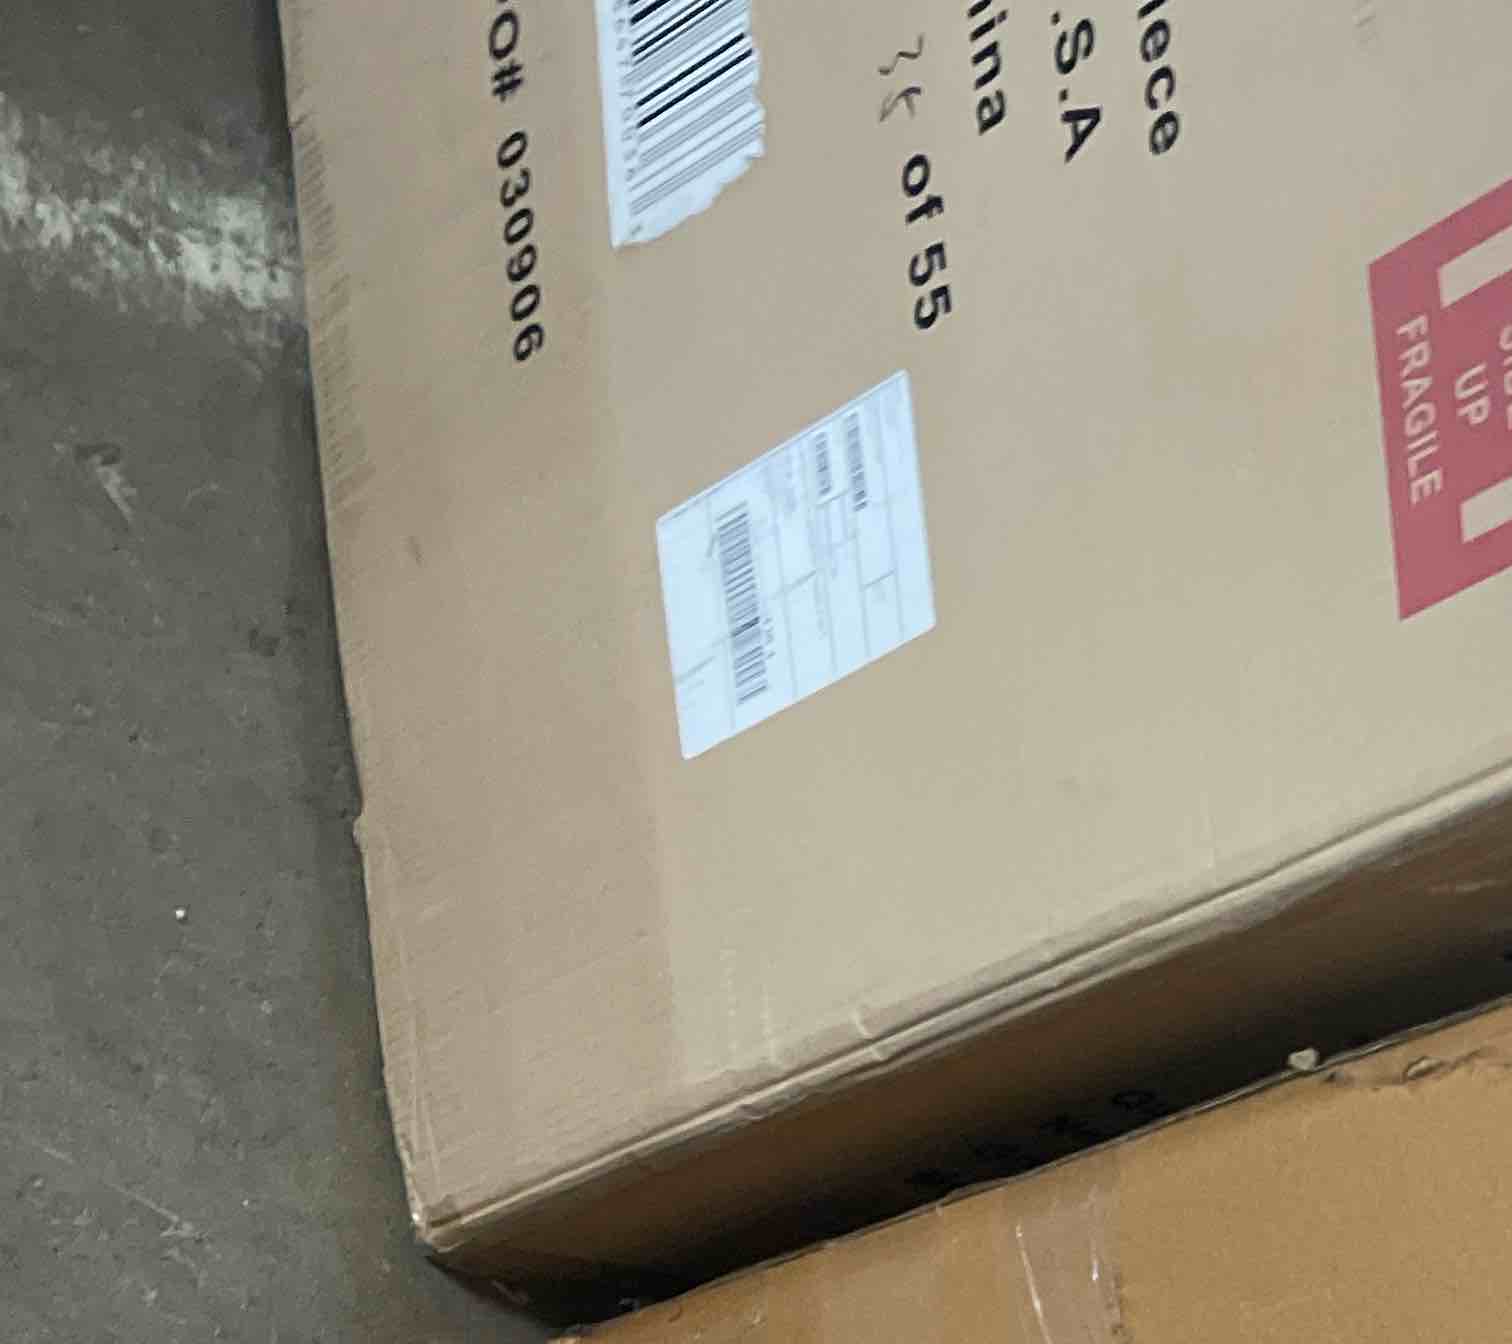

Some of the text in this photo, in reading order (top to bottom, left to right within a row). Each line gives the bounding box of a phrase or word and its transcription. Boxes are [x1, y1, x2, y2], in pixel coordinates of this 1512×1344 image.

[489, 0, 545, 362] O# 030906
[902, 154, 952, 330] of 55
[1397, 314, 1443, 503] FRAGILE
[1455, 365, 1490, 427] UP
